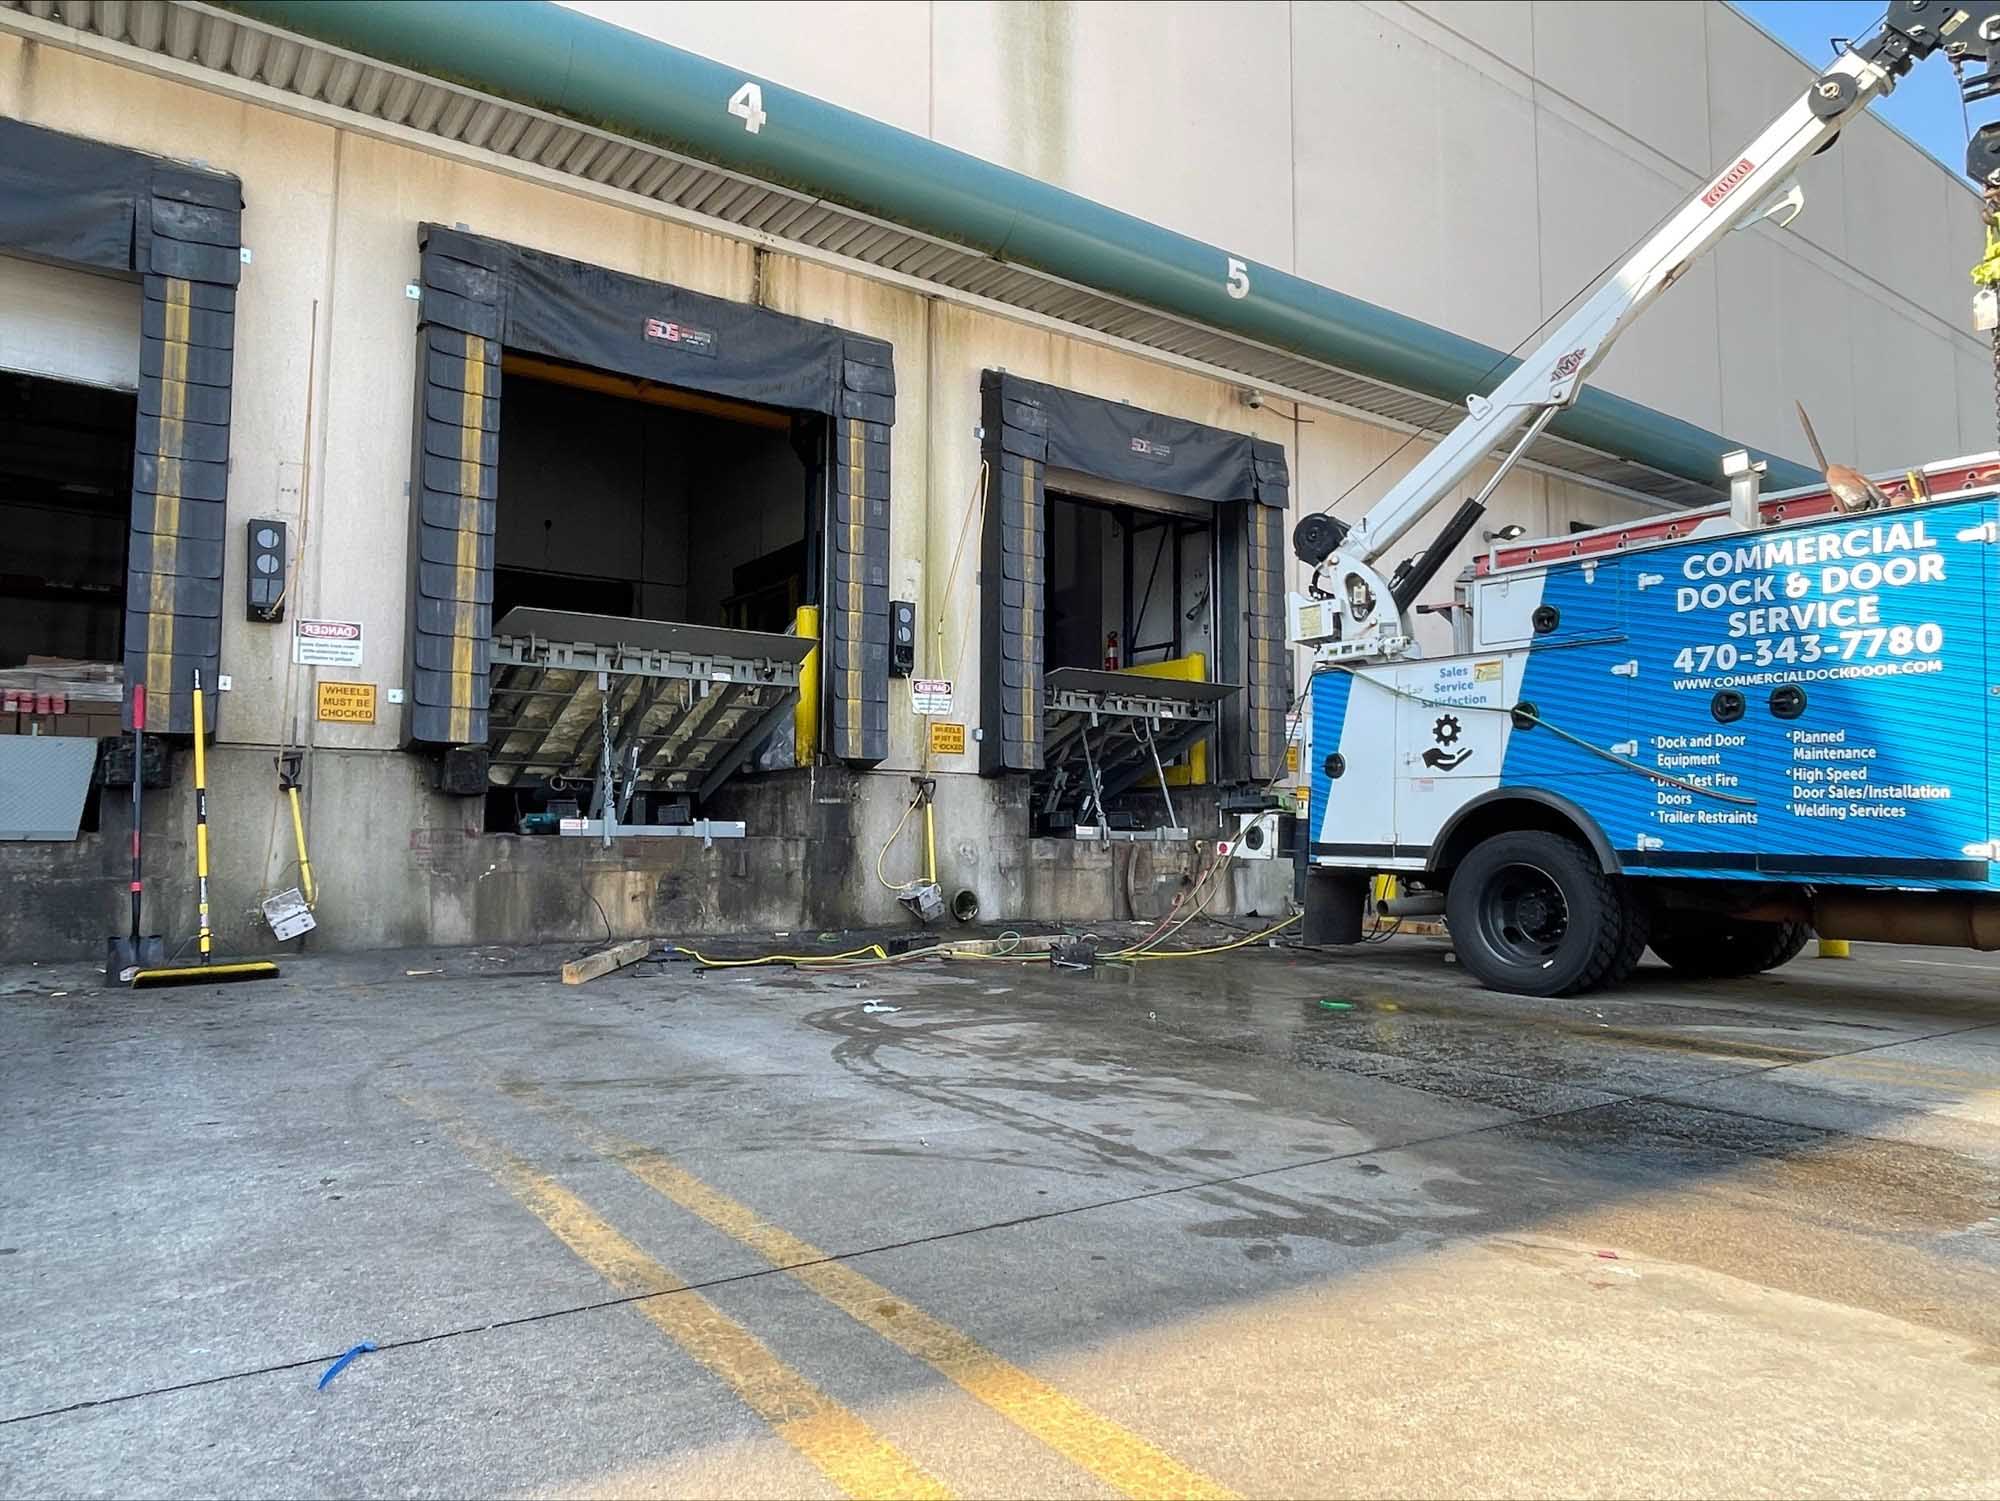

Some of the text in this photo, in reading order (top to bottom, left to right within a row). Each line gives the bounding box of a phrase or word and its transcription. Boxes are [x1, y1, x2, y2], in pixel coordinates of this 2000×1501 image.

[727, 82, 767, 134] 4
[1706, 162, 1750, 204] 6000
[1227, 257, 1250, 299] 5
[1683, 520, 1937, 580] COMMERCIAL
[1677, 554, 1946, 612] DOCK & DOOR
[1728, 595, 1880, 638] SERVICE
[1673, 623, 1943, 673] 470-343-7780
[1439, 666, 1468, 678] Sales
[1673, 660, 1942, 691] WWW.COMMERCIALDOCKDOOR.COM
[325, 686, 370, 697] WHEELS
[1434, 681, 1474, 693] Service
[323, 697, 371, 708] MUST BE
[320, 709, 373, 719] CHOCKED
[1657, 734, 1746, 749] Dock and Door
[1793, 730, 1845, 743] Planned
[1657, 753, 1721, 768] Equipment
[1793, 747, 1877, 760] Maintenance
[1687, 774, 1712, 786] Test
[1715, 773, 1738, 786] Fire
[1793, 767, 1868, 783] High Speed
[1657, 792, 1692, 804] Doors
[1793, 784, 1951, 799] Door Sales/Installation
[1658, 811, 1758, 824] Trailer Restraints
[1793, 803, 1906, 820] Welding Services
